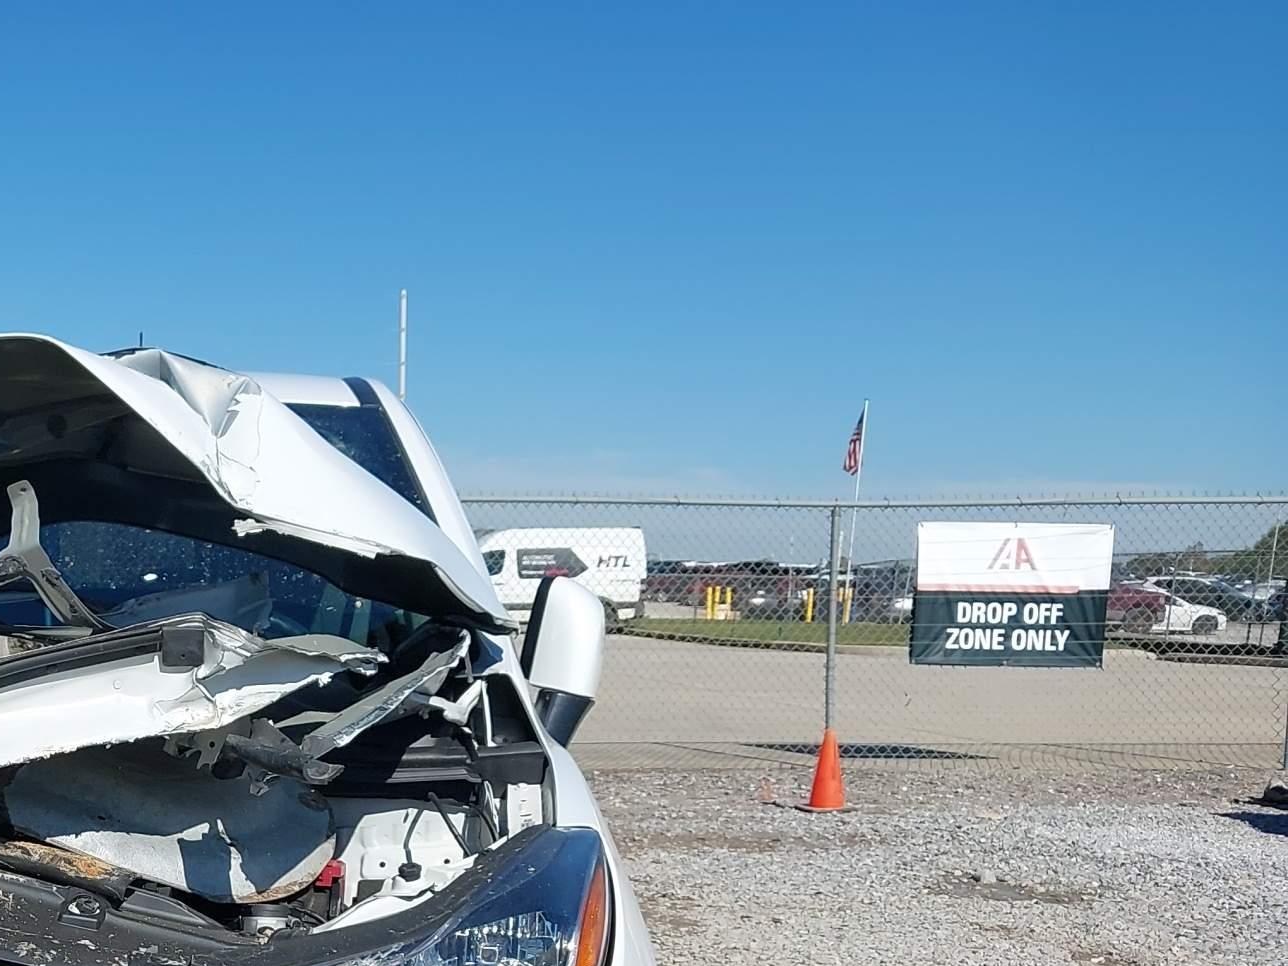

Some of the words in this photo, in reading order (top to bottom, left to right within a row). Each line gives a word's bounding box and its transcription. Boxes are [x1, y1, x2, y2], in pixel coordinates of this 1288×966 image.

[596, 555, 631, 568] HTL
[956, 601, 1018, 624] DROP
[1023, 602, 1065, 625] OFF
[944, 627, 1005, 650] ZONE
[1011, 628, 1071, 651] ONLY
